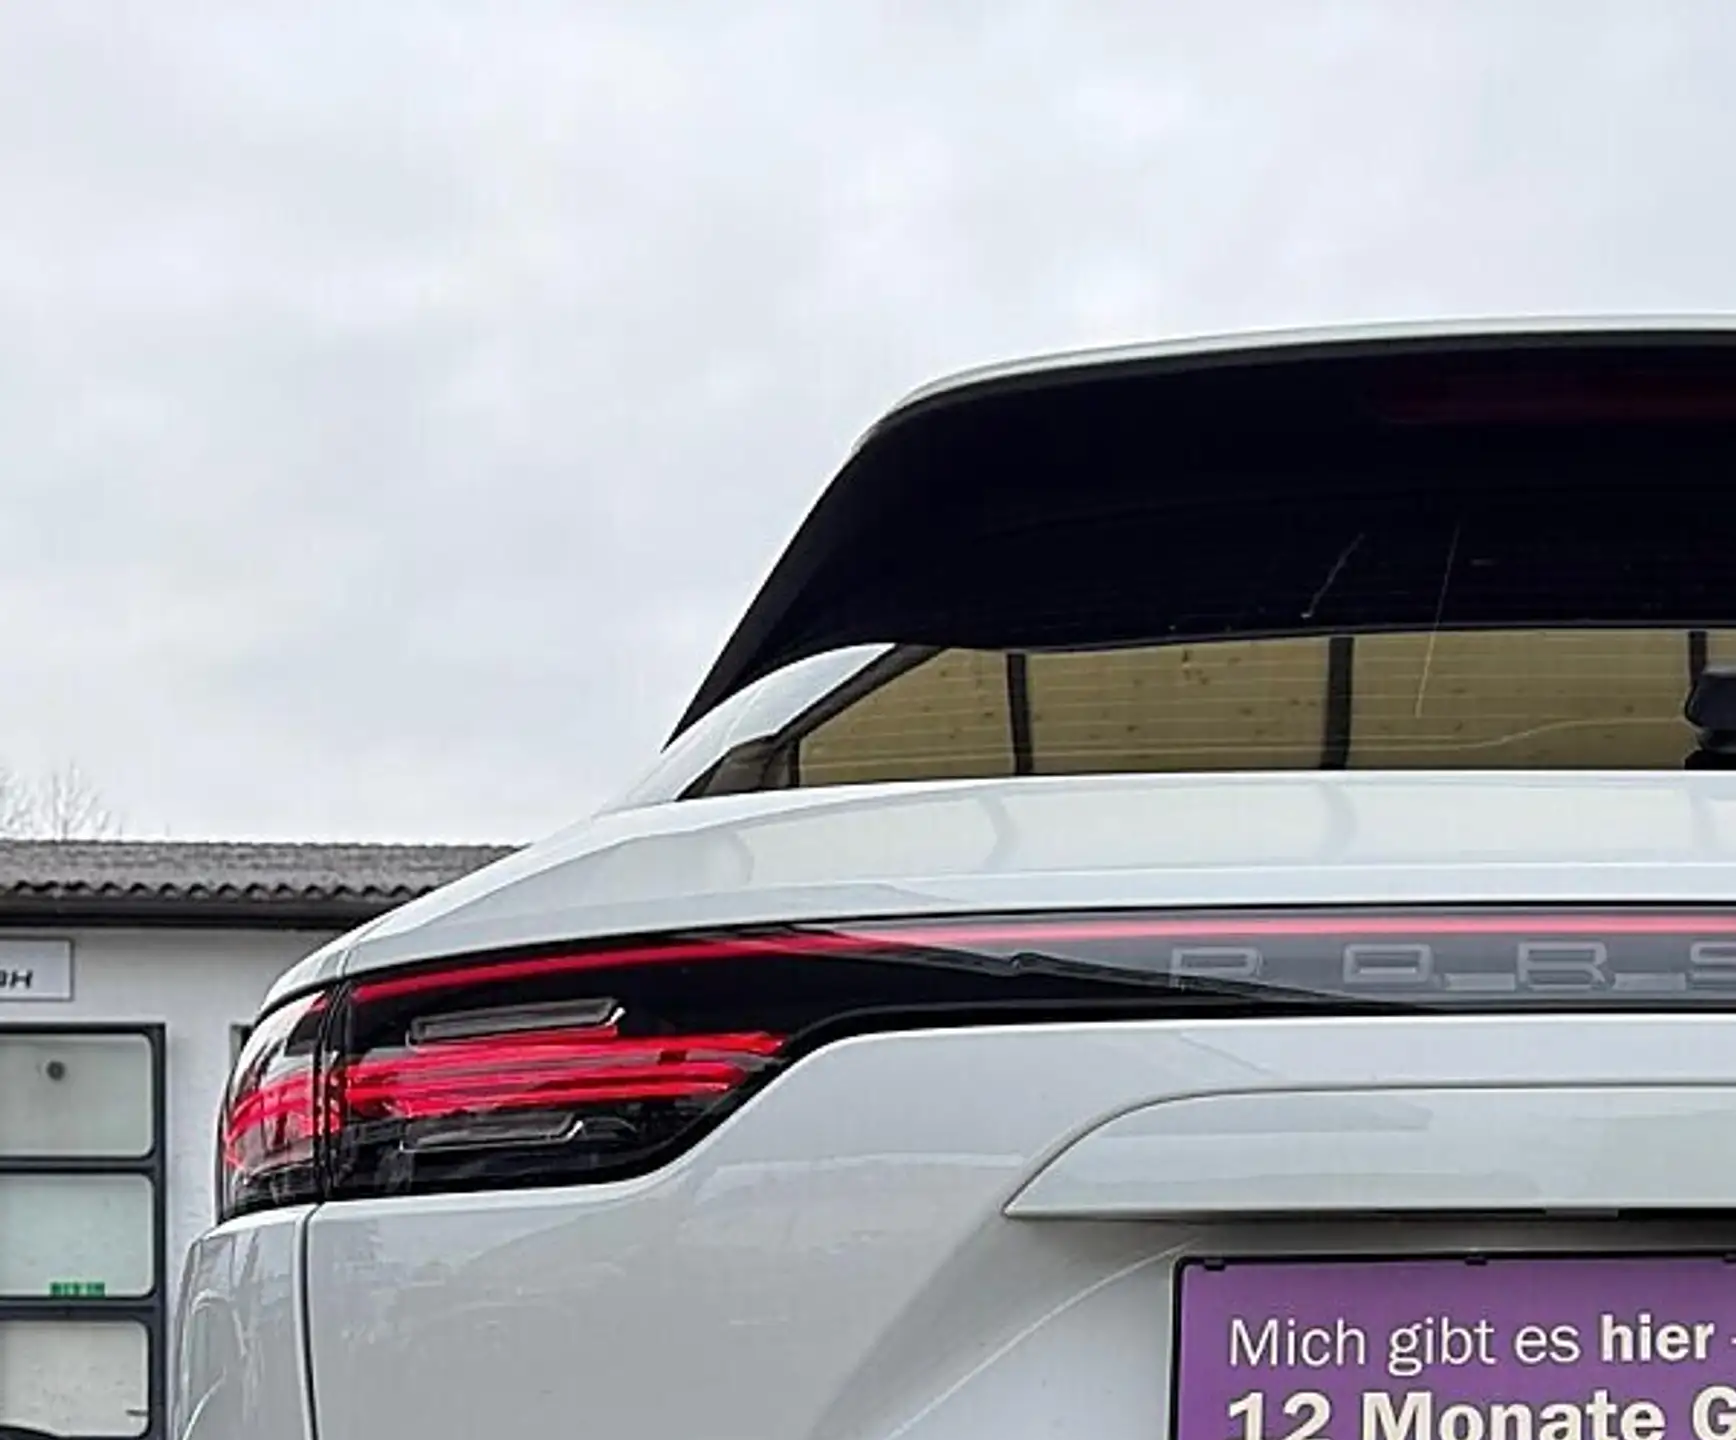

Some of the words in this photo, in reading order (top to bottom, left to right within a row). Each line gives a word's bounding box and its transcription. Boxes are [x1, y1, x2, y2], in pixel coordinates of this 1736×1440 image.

[1228, 1317, 1367, 1368] Mich
[1387, 1315, 1498, 1378] gibt
[1513, 1324, 1582, 1365] es
[1600, 1313, 1716, 1363] hier
